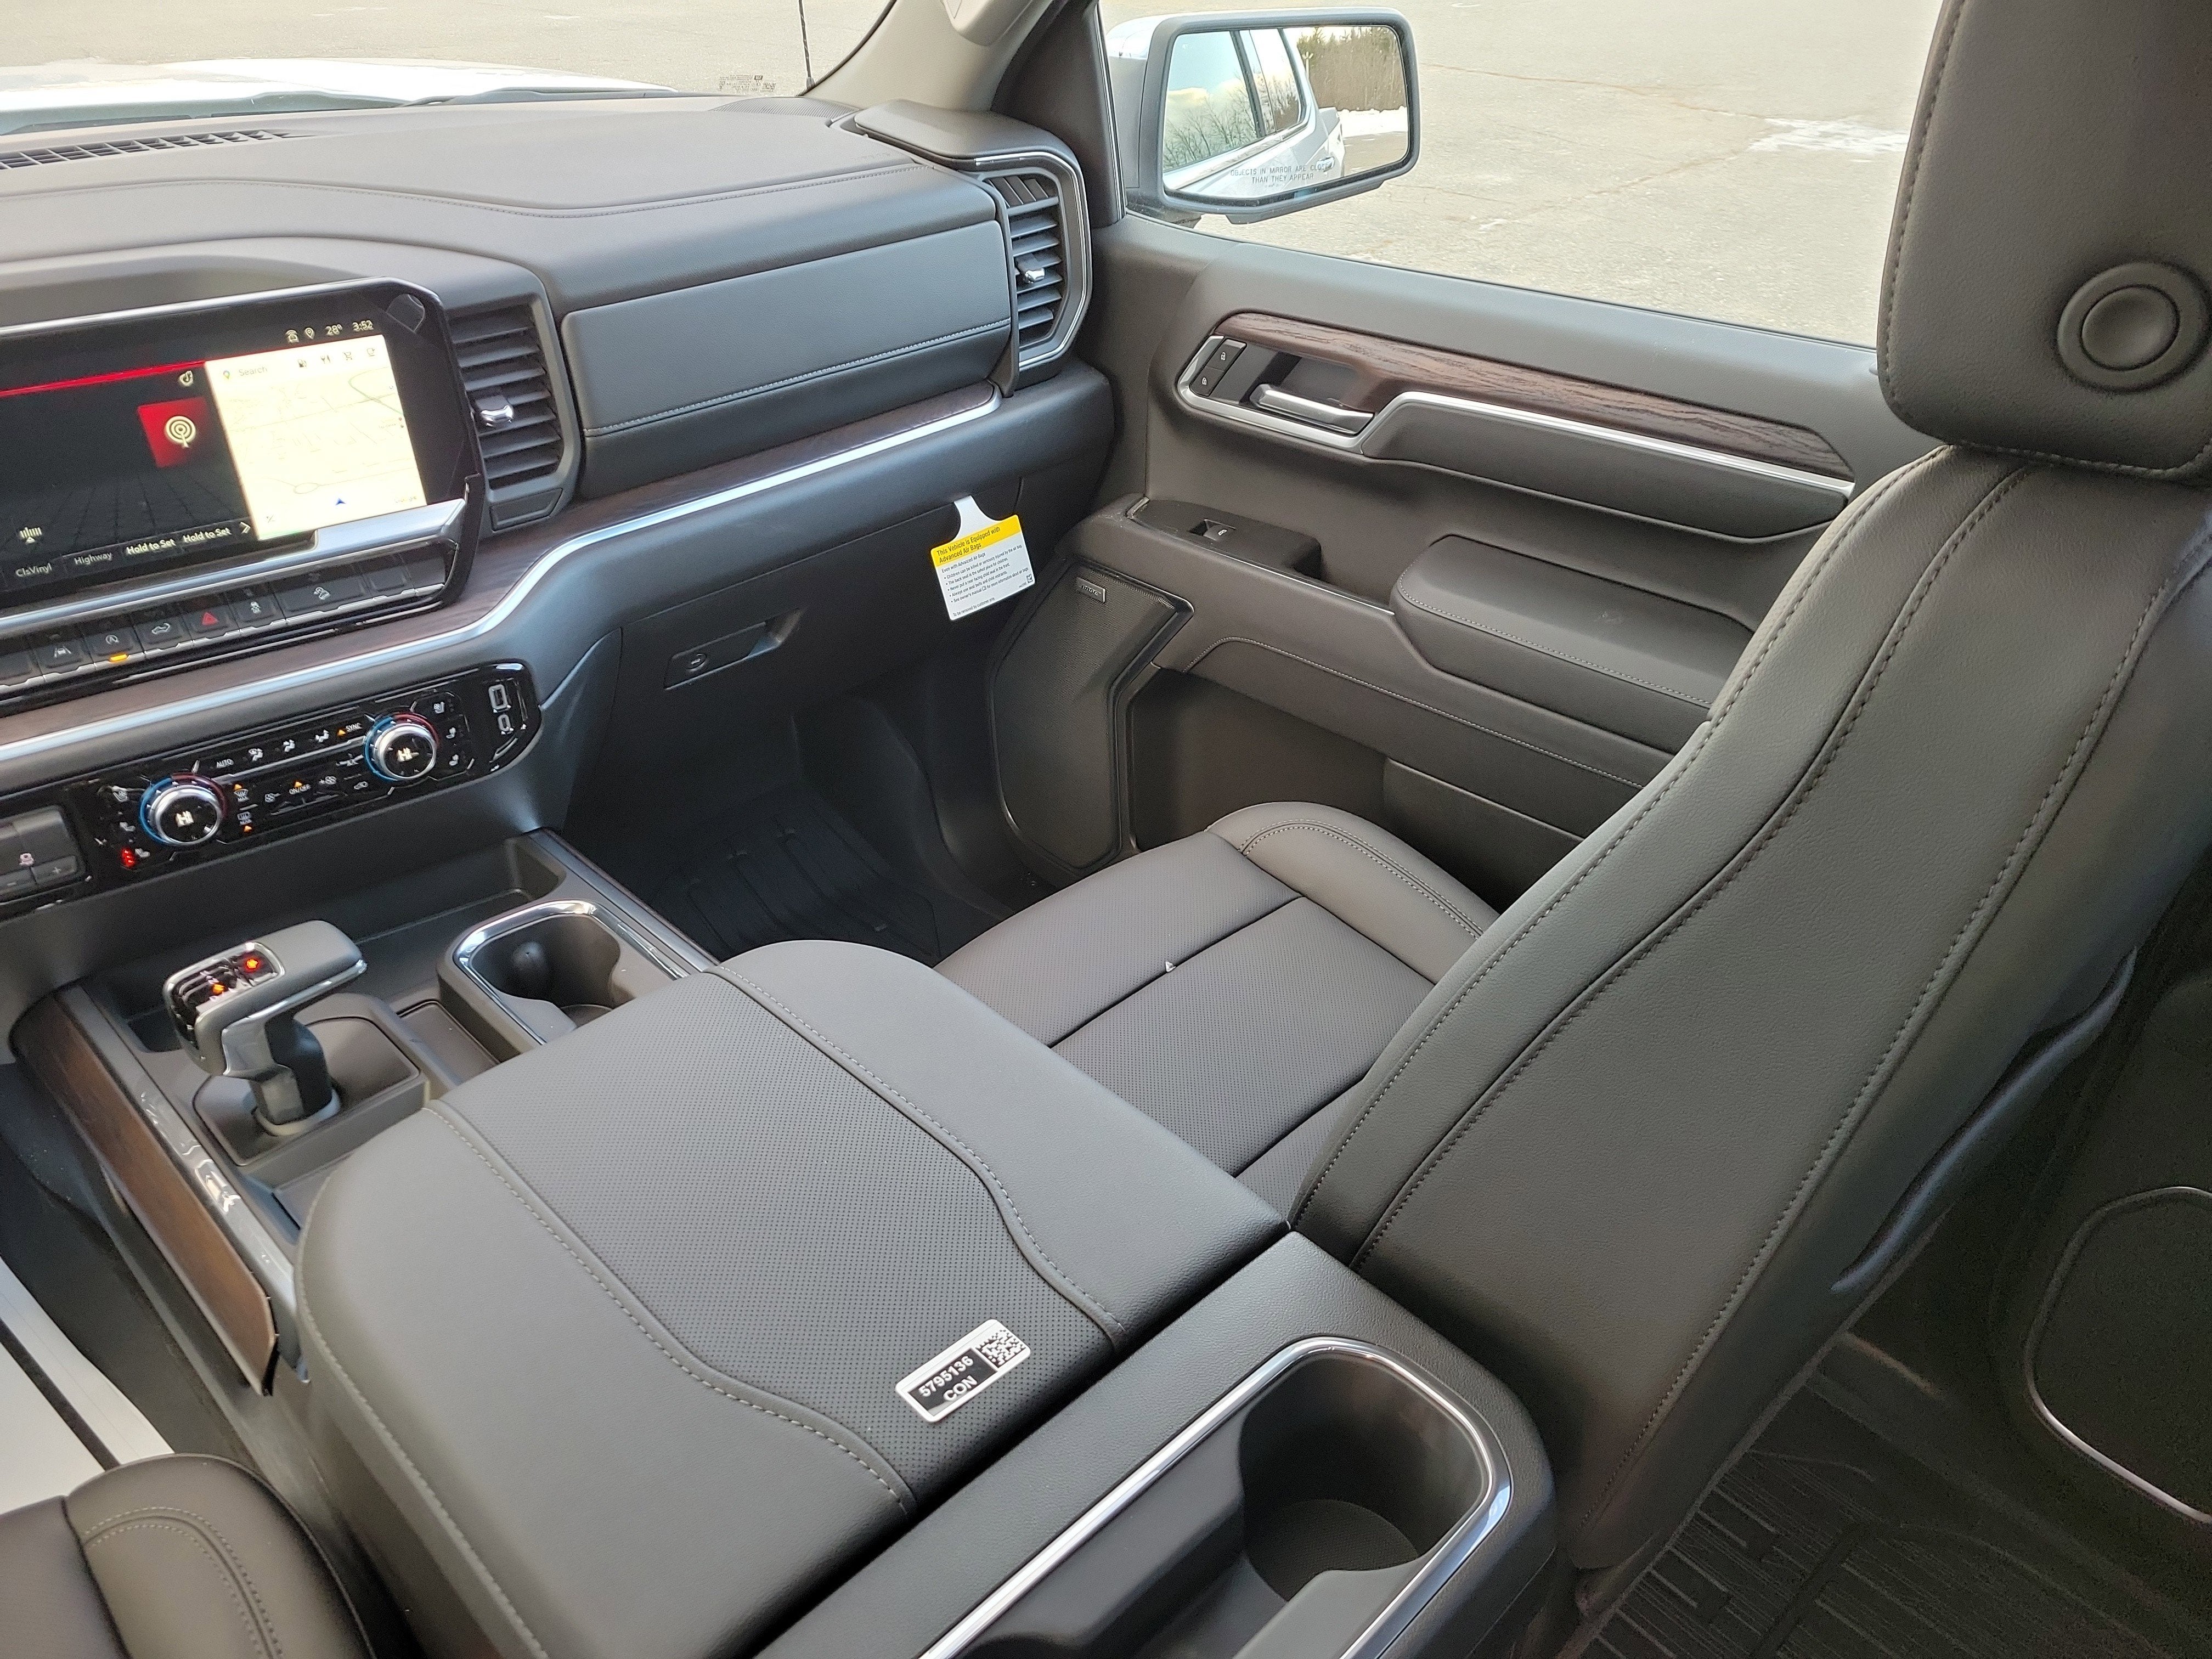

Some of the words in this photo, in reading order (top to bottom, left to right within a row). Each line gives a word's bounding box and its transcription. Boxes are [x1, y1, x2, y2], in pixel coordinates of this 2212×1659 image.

[1289, 173, 1314, 181] APPEAR
[352, 319, 374, 332] 3:52
[238, 365, 268, 377] Search
[183, 533, 204, 543] Hold
[205, 530, 215, 539] to
[215, 527, 232, 537] Set
[936, 547, 947, 557] This
[948, 540, 965, 552] Vehicle
[970, 530, 991, 544] Equipped
[990, 526, 1000, 534] with
[126, 545, 148, 556] Hold
[148, 541, 159, 551] to
[159, 538, 176, 549] Set
[938, 549, 962, 564] Advanced
[970, 541, 981, 552] Bags
[74, 551, 113, 566] Highway
[957, 557, 973, 567] Advanced
[16, 562, 52, 577] ClsVinyl
[946, 571, 960, 579] Children
[346, 722, 363, 732] SYNC
[397, 747, 413, 763] HI
[216, 758, 234, 769] AUTO
[289, 783, 312, 795] ON/OFF
[174, 810, 194, 828] HI
[918, 1356, 974, 1397] 5795136
[943, 1375, 978, 1402] CON
